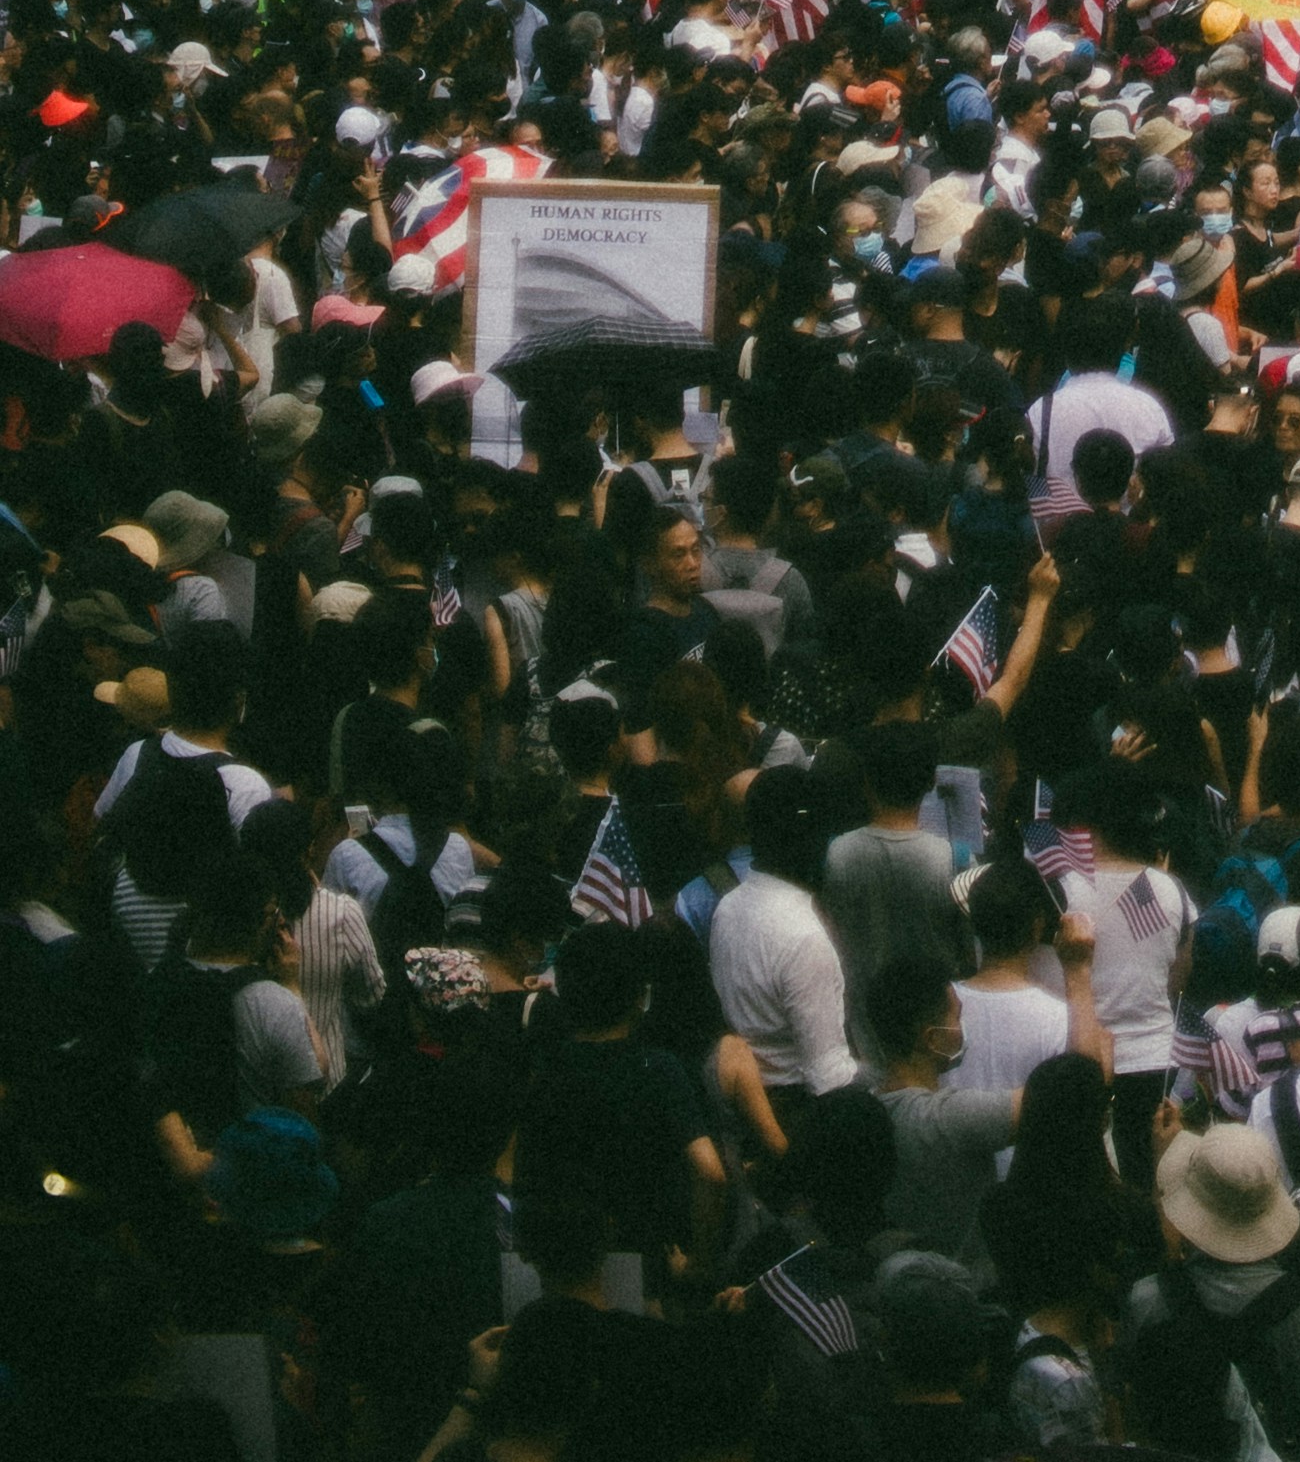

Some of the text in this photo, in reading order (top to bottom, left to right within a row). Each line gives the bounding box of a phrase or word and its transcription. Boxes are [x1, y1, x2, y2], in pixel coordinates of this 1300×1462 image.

[531, 205, 662, 222] HUMAN RIGHTS
[543, 228, 647, 244] DEMOCRACY
